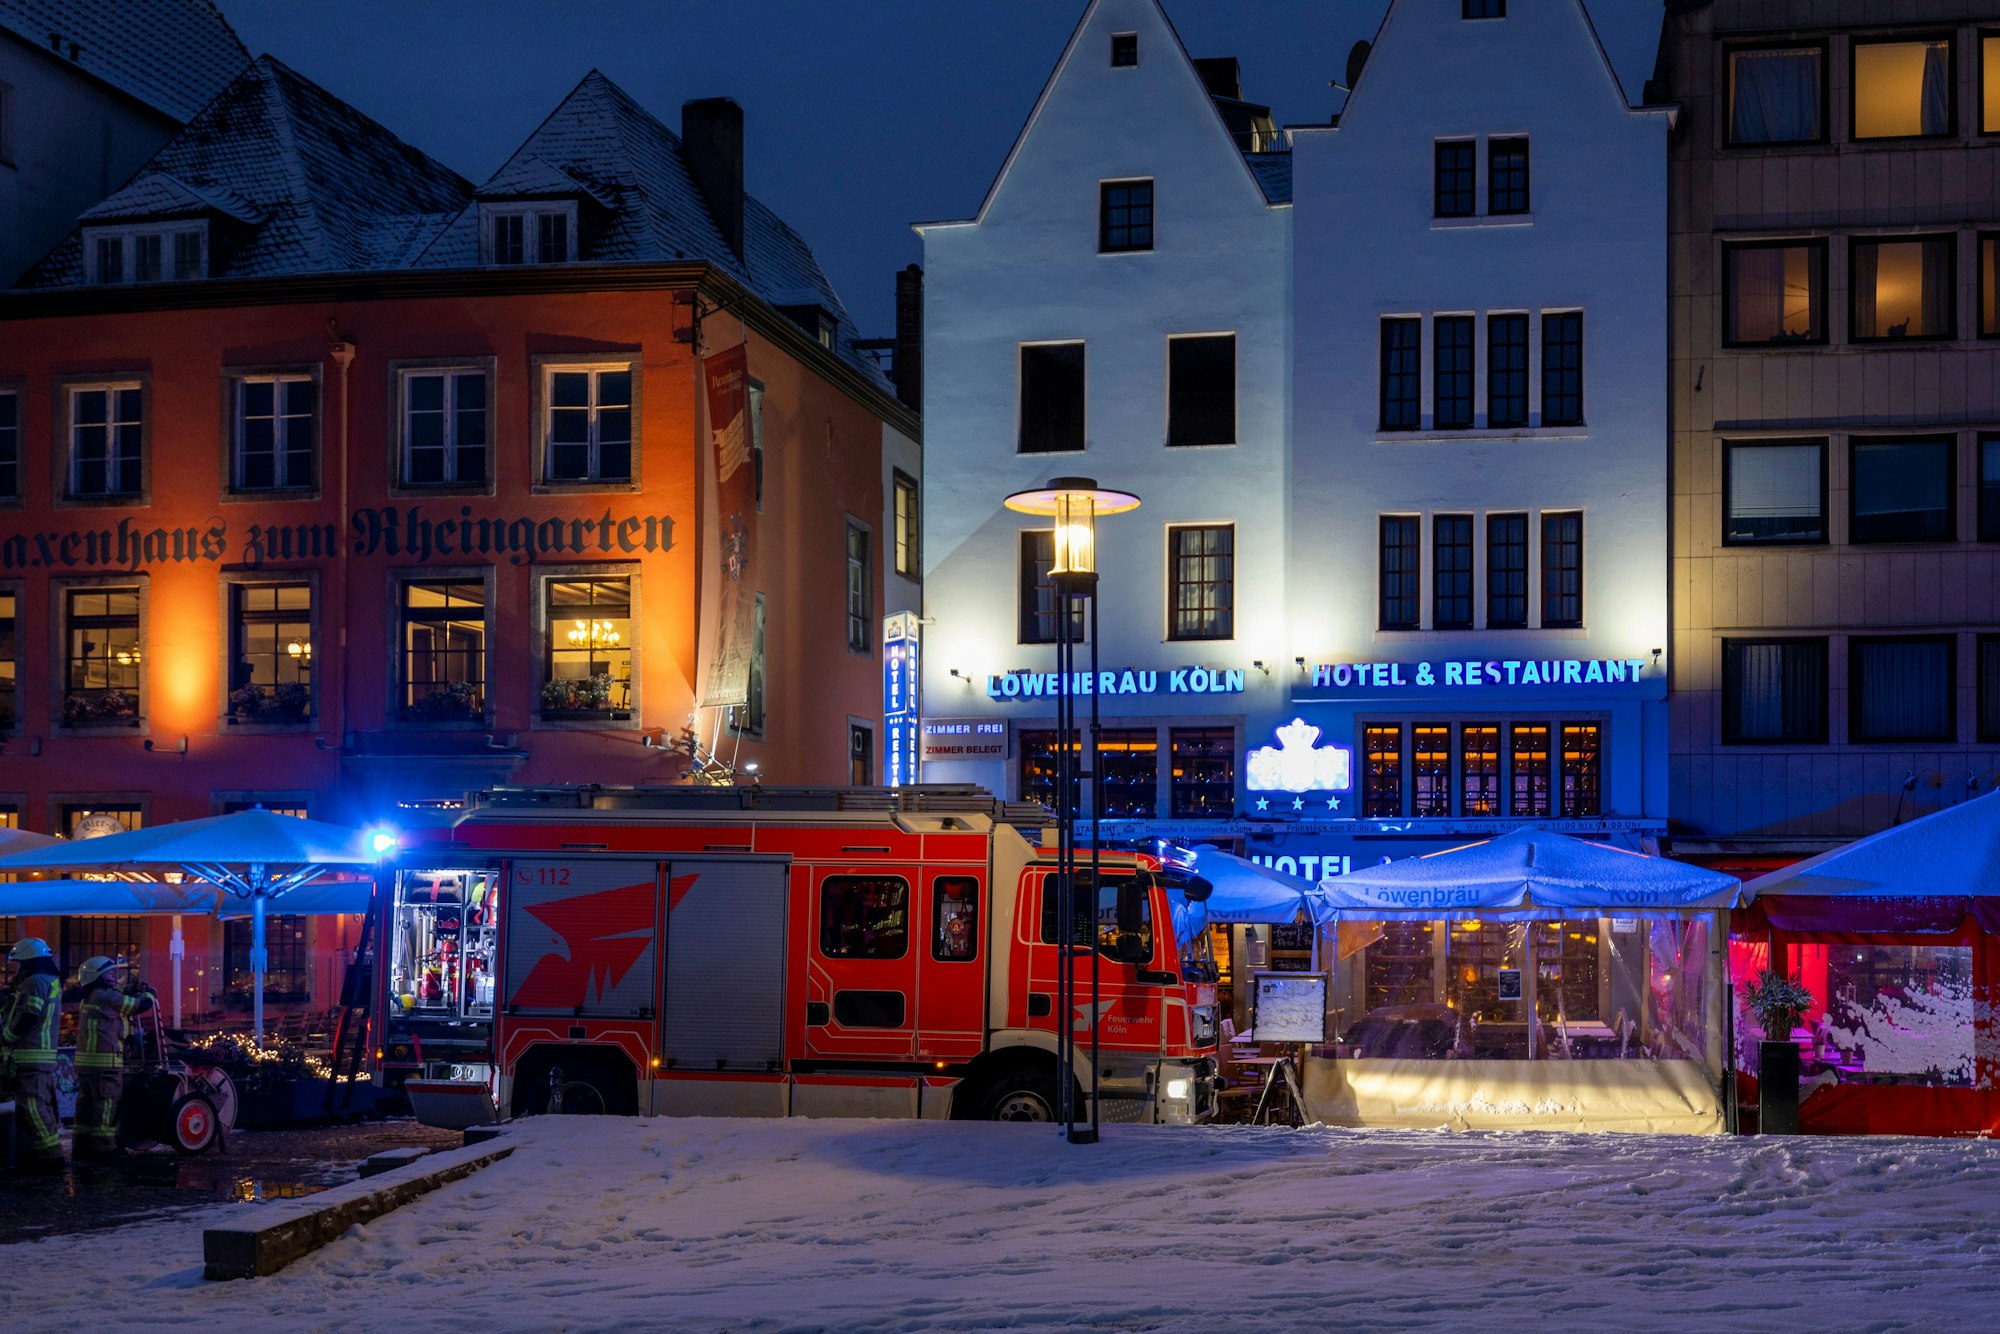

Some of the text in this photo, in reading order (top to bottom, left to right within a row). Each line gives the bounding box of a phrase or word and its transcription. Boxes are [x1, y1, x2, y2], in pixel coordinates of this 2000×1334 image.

[3, 505, 679, 572] axenhaus zum Rheingarten
[891, 645, 899, 708] HOTEL
[1312, 659, 1645, 687] HOTEL & RESTAURANT
[1170, 666, 1245, 693] KÖLN
[925, 724, 1003, 734] ZIMMER FREI
[926, 745, 1003, 754] ZIMMER BELEGT
[1145, 825, 1178, 833] Deutsche
[1187, 825, 1228, 833] Italienische
[1625, 821, 1642, 829] Uhr
[538, 868, 569, 885] 112
[1107, 1014, 1153, 1024] Feuerwehr
[1107, 1024, 1127, 1034] Köln
